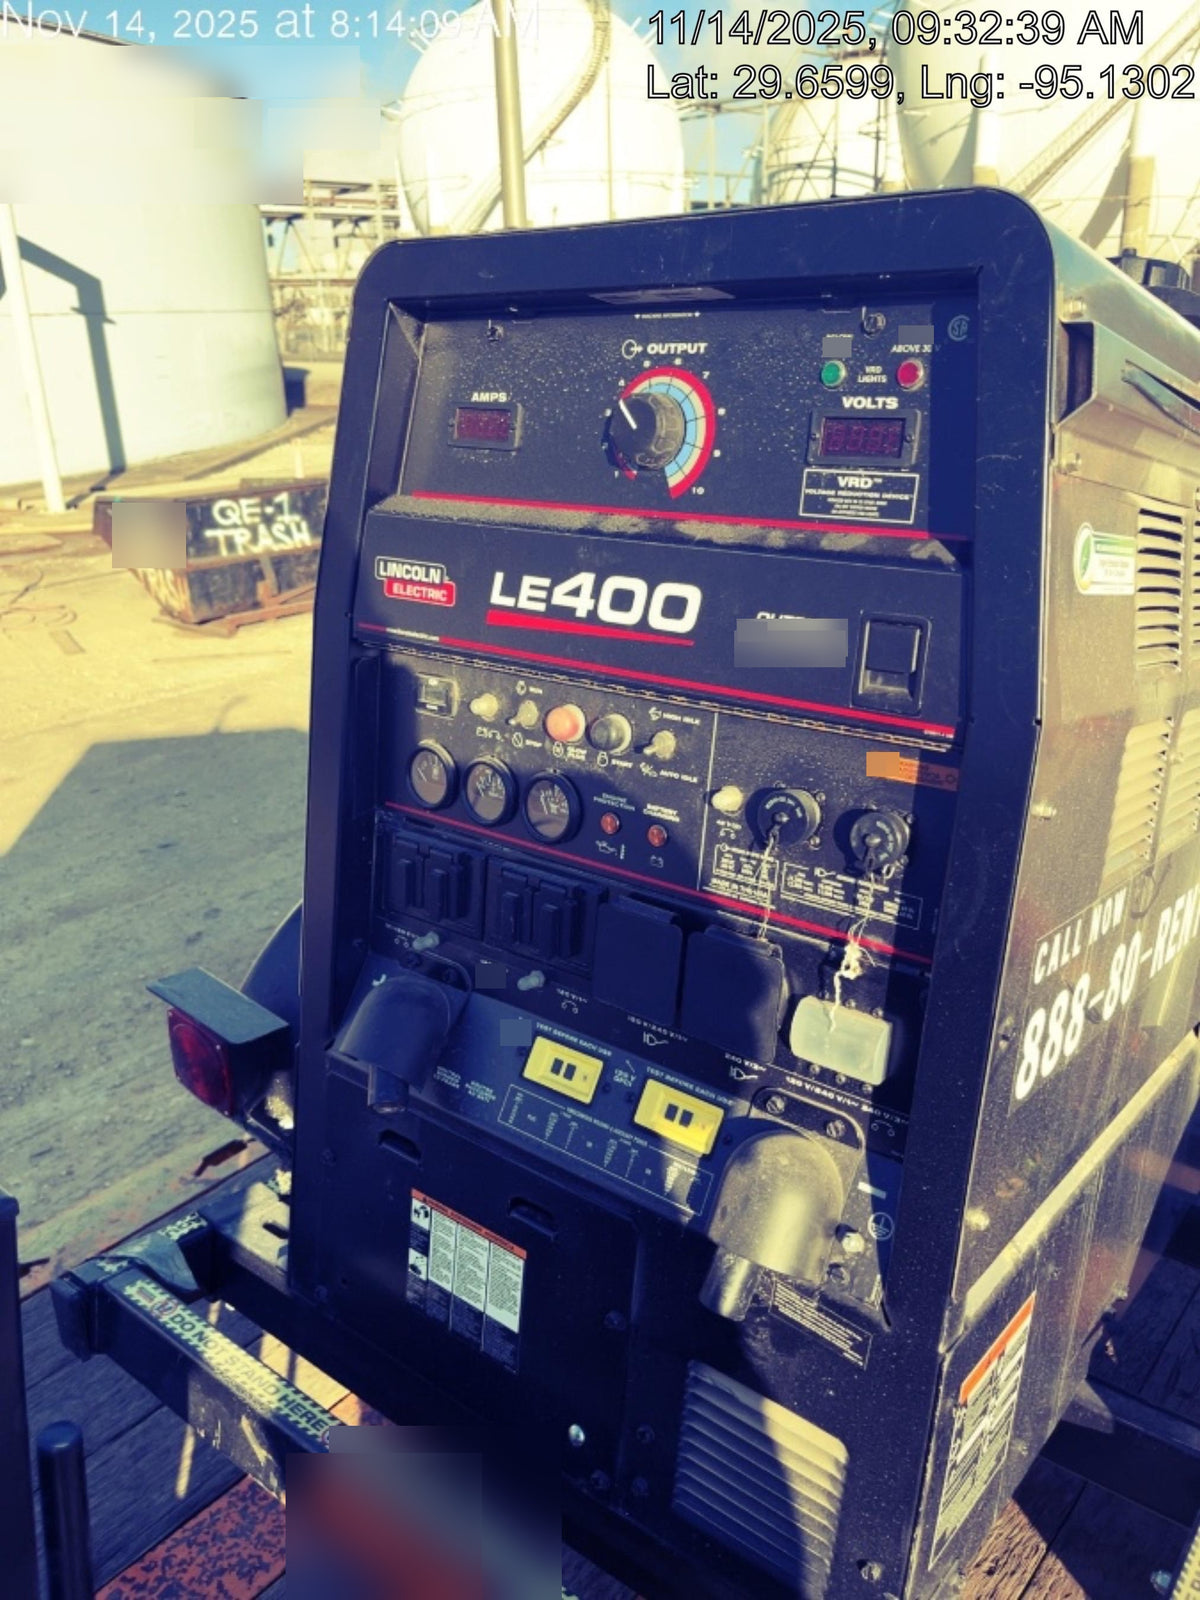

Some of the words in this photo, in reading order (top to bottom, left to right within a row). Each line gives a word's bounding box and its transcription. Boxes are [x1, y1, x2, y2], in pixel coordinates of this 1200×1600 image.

[647, 342, 708, 355] OUTPUT
[857, 374, 888, 384] LIGHTS
[471, 391, 508, 403] AMPS
[841, 395, 899, 410] VOLTS
[212, 491, 302, 526] QE-1
[204, 520, 312, 557] TRASH
[379, 560, 442, 584] LINCOLN
[392, 582, 448, 602] ELECTRIC
[489, 571, 703, 634] LE400
[1033, 918, 1083, 985] CALL
[1088, 887, 1128, 946] NOW
[169, 1311, 197, 1332] DO
[193, 1329, 226, 1358] NOT
[223, 1353, 280, 1396] STAND
[277, 1393, 328, 1433] HERE
